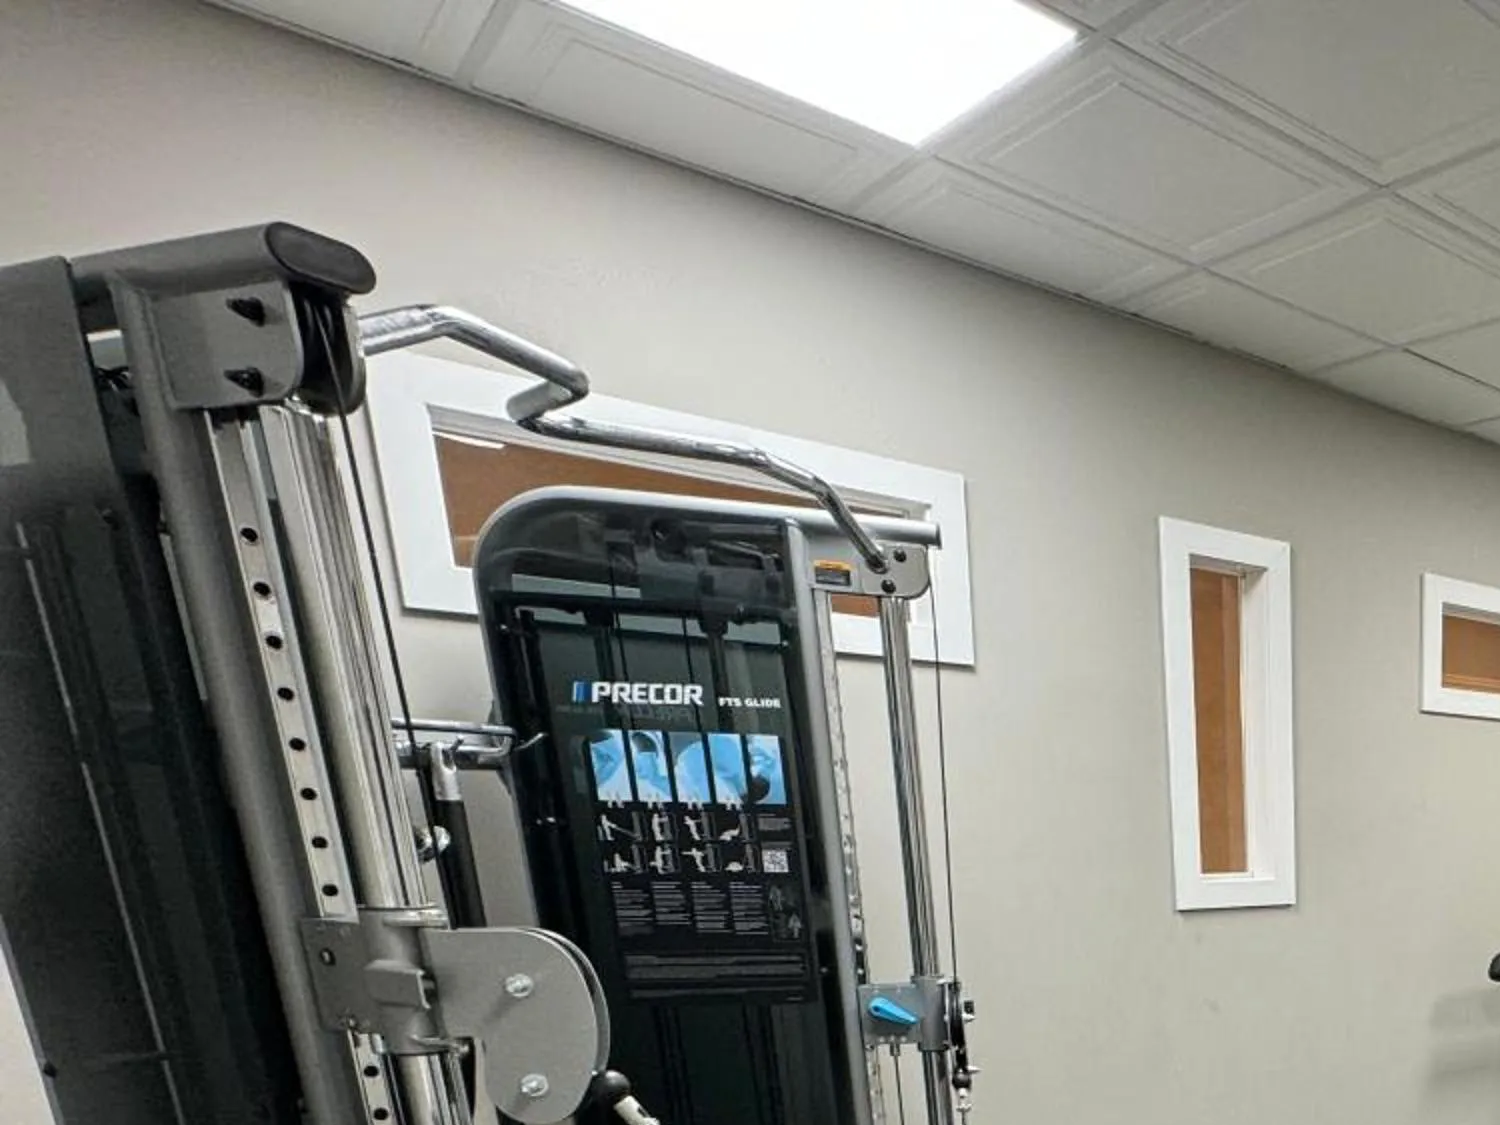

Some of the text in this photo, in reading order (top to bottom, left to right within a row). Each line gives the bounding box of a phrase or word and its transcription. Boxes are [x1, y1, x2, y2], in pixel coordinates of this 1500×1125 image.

[591, 681, 704, 706] PRECOR
[718, 696, 781, 709] FTS GLIDE
